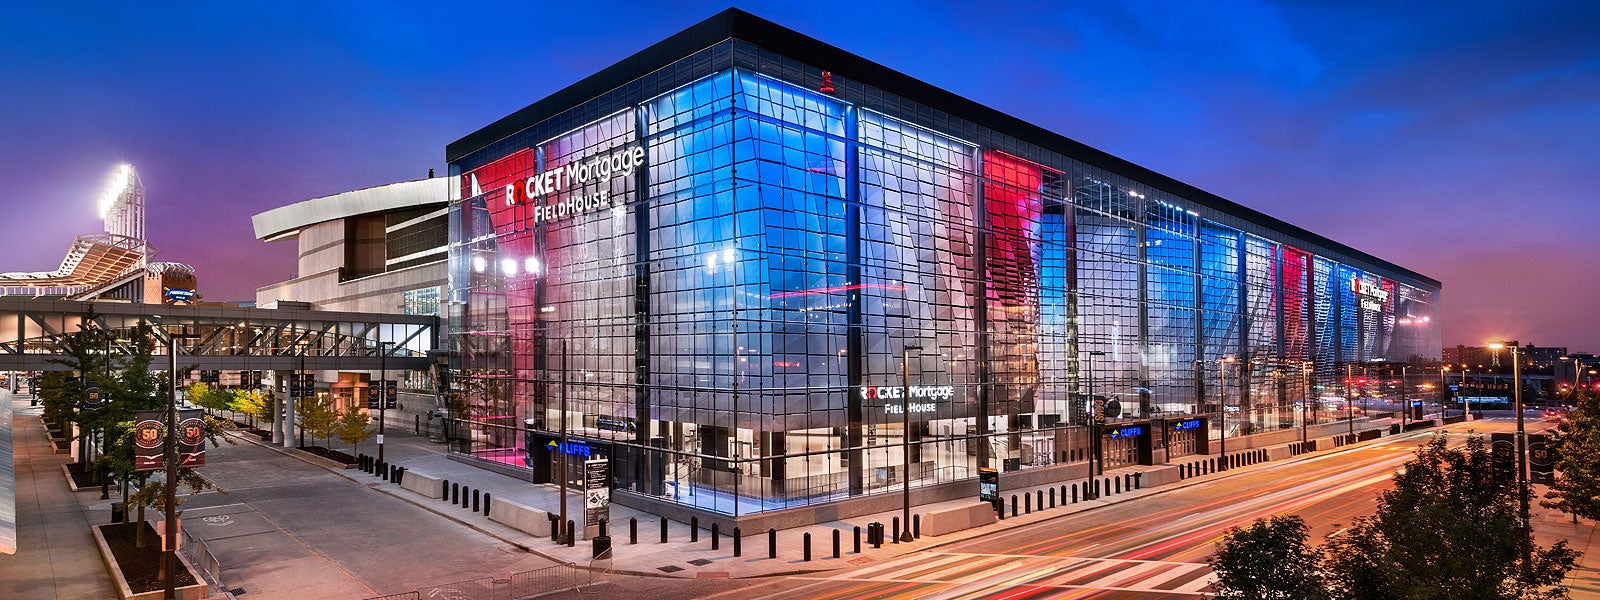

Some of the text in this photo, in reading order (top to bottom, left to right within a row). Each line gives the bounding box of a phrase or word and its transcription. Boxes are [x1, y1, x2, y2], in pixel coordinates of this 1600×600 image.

[505, 146, 645, 206] ROCKET Mortgage
[909, 385, 954, 400] Mortgage
[885, 403, 936, 414] FIELHOUSE
[1182, 420, 1200, 429] CLIFFS
[142, 429, 158, 440] 50
[186, 427, 200, 437] 50
[1120, 427, 1141, 438] CLIFFS
[1534, 450, 1548, 459] 50
